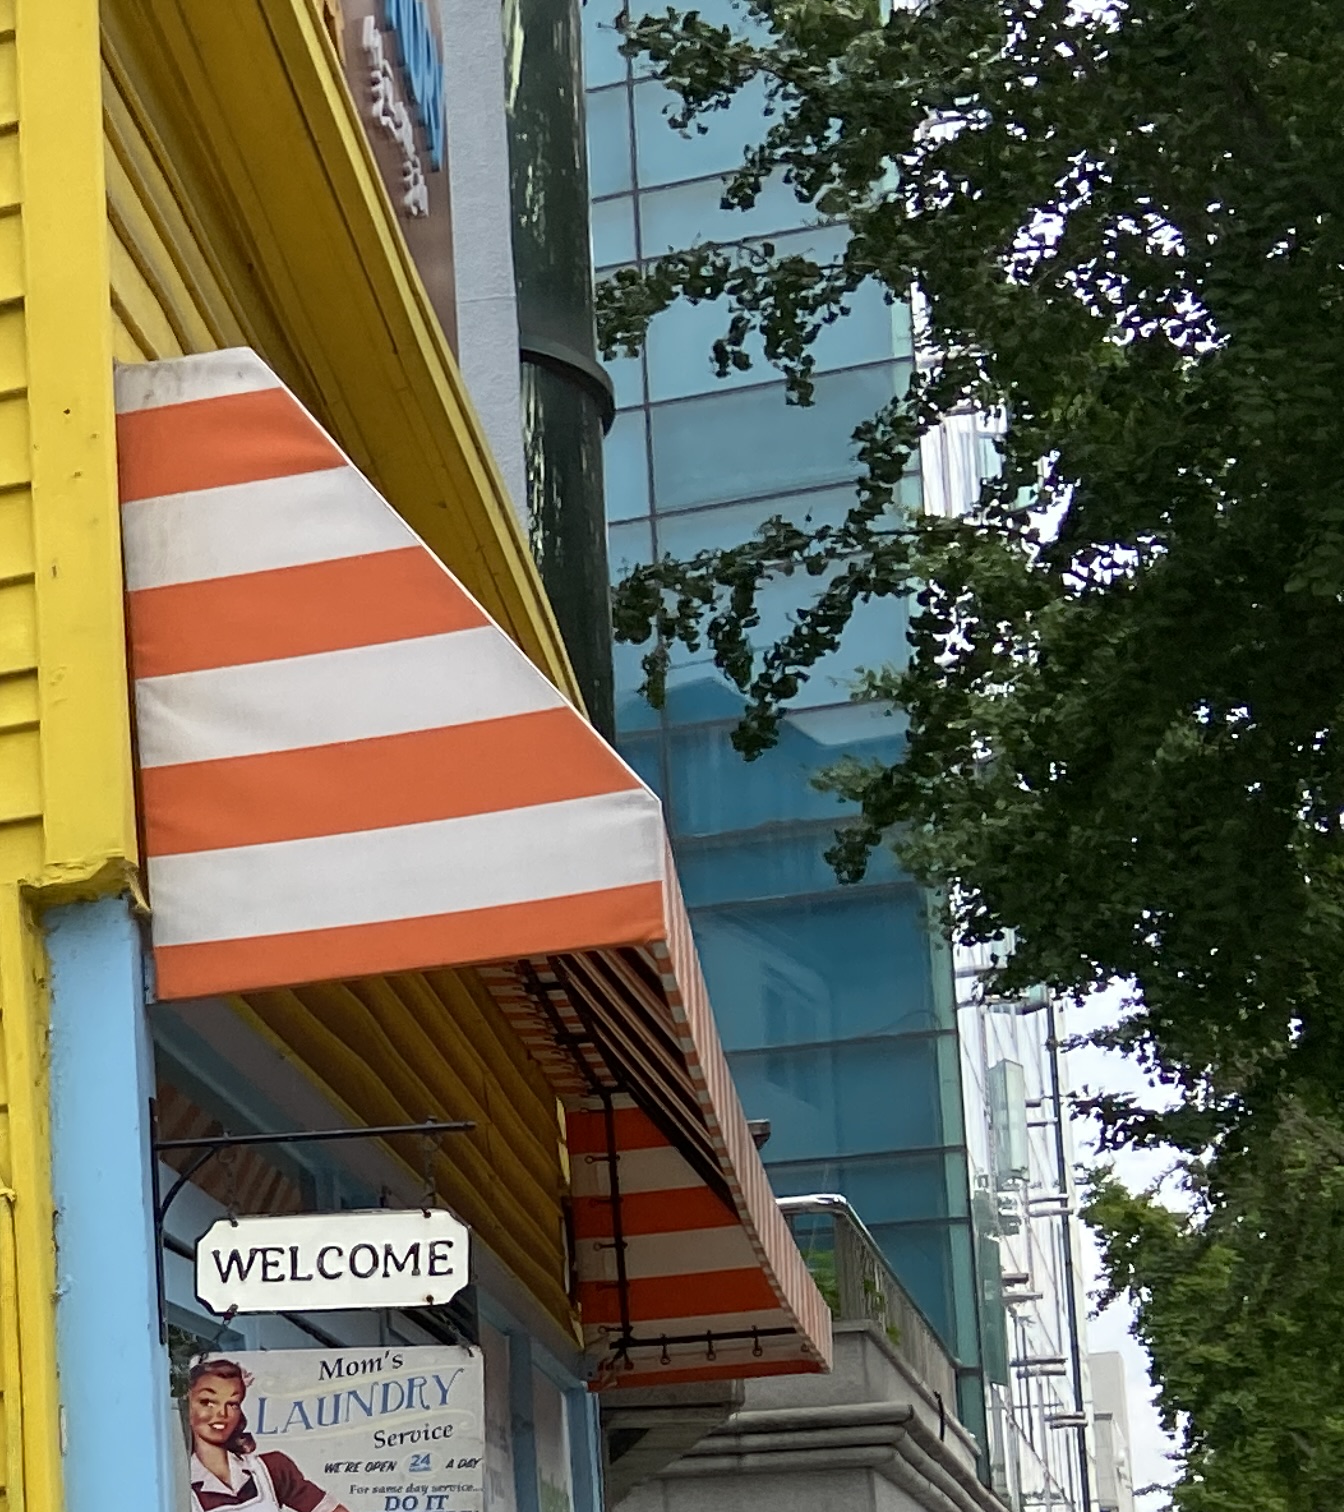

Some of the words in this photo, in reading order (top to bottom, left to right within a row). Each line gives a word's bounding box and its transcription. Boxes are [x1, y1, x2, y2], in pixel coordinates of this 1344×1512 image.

[212, 1240, 455, 1284] WELCOME
[318, 1350, 404, 1381] Mom's
[256, 1368, 465, 1435] LAUNDRY
[374, 1423, 454, 1450] Service
[365, 1460, 398, 1473] OPEN
[410, 1453, 432, 1468] 24
[457, 1458, 483, 1469] DAY
[349, 1484, 370, 1494] For
[372, 1484, 403, 1494] same
[405, 1483, 428, 1494] day
[385, 1495, 419, 1511] DO
[426, 1494, 449, 1510] IT
